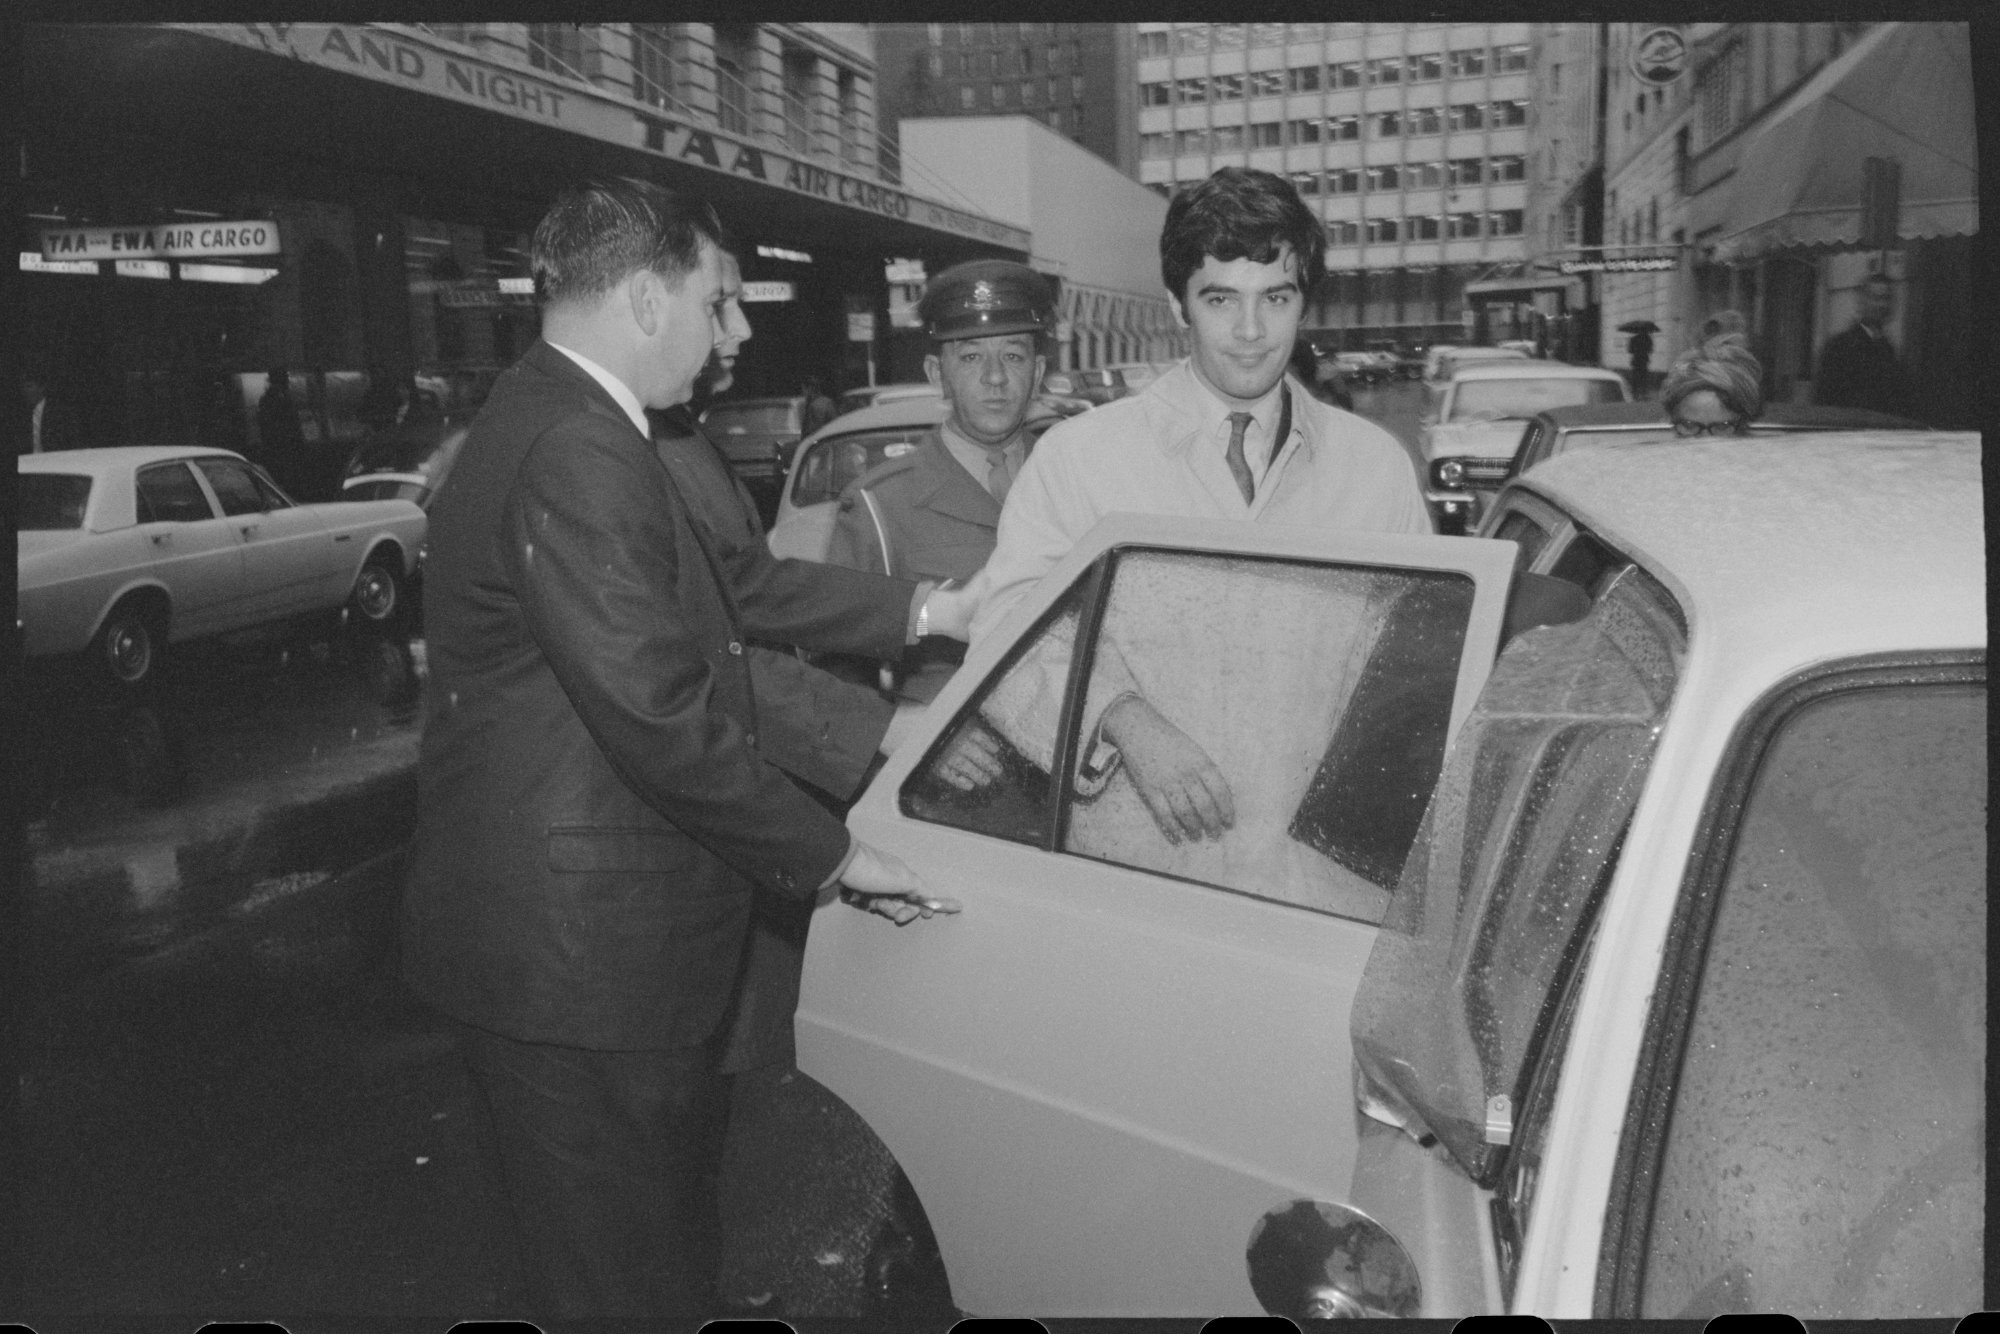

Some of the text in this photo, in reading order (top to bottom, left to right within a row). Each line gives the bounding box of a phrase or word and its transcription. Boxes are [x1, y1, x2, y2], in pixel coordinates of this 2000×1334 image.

[321, 27, 425, 80] AND
[445, 59, 564, 120] NIGHT
[633, 113, 768, 182] TAA
[785, 161, 829, 197] AIR
[837, 173, 908, 218] CARGO
[48, 233, 87, 253] TAA
[111, 231, 155, 250] EWA
[163, 230, 194, 249] AIR
[200, 227, 267, 248] CARGO
